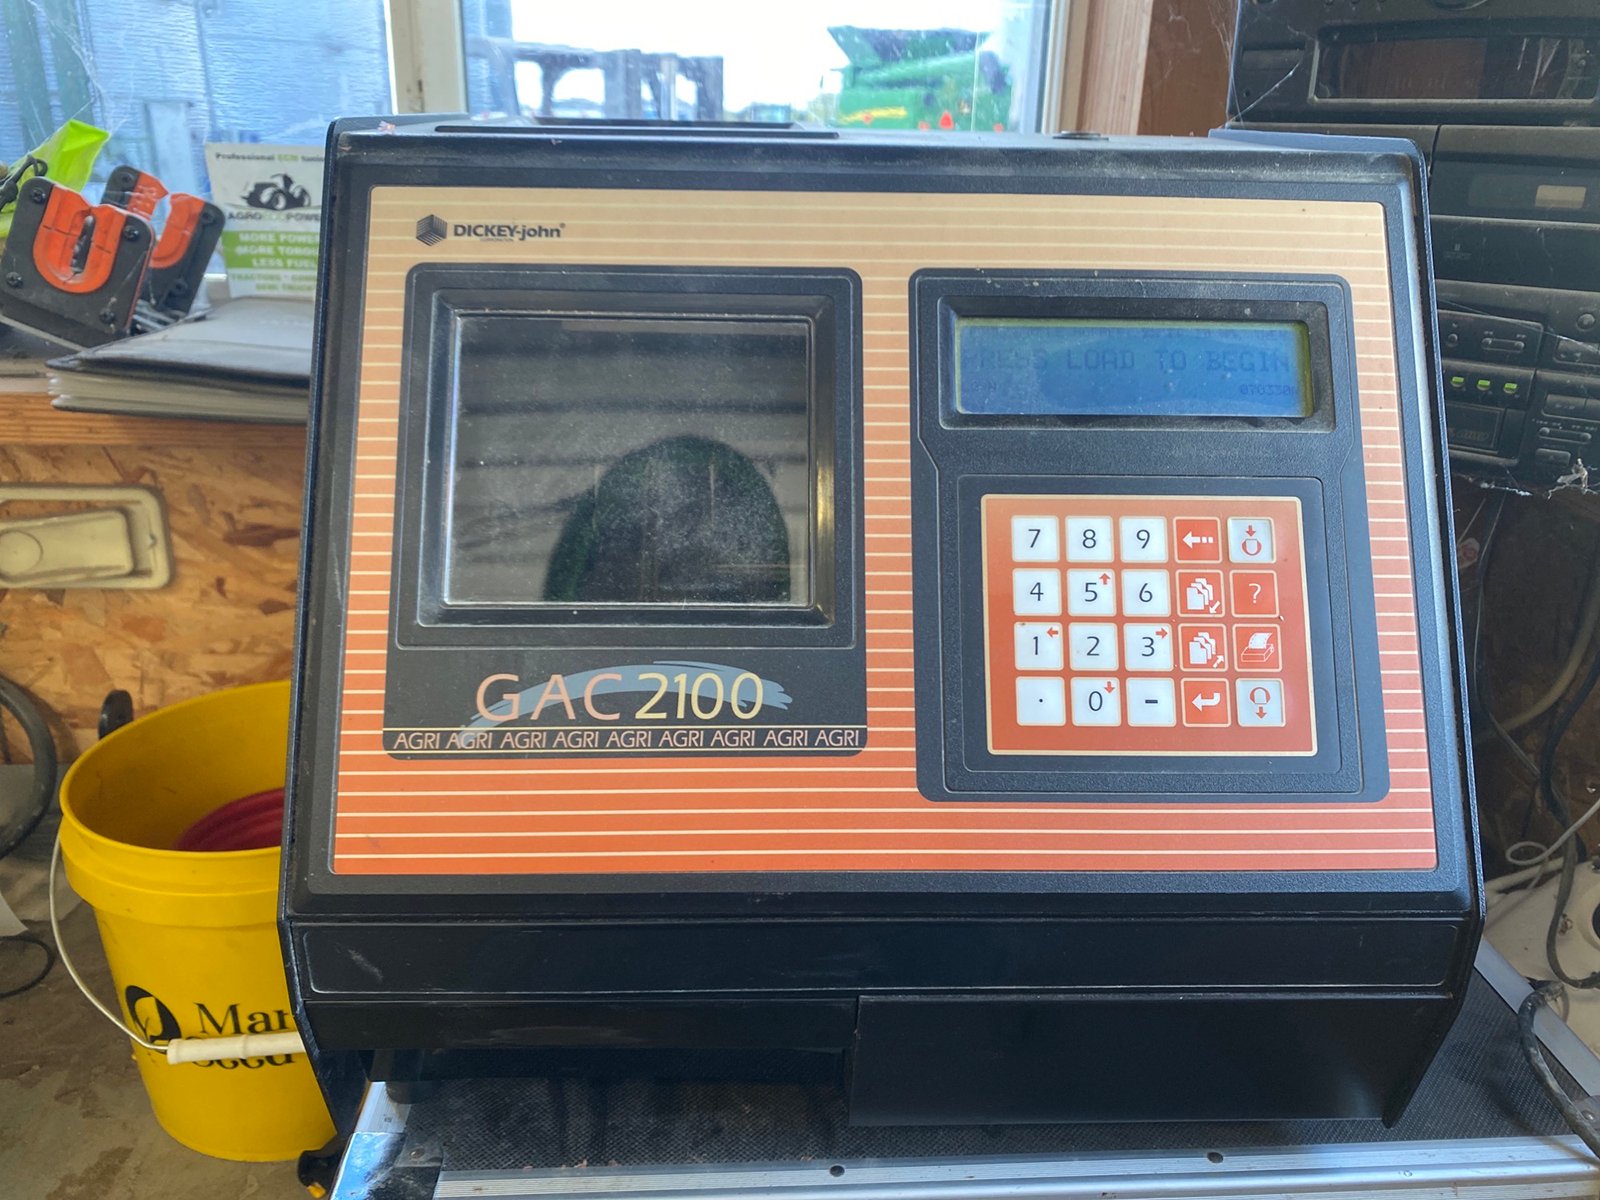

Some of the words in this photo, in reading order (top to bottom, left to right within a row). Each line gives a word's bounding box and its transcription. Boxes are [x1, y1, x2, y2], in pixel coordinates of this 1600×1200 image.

[239, 232, 276, 243] MORE
[1066, 349, 1136, 370] LOAD
[1154, 349, 1188, 371] TO
[1206, 350, 1291, 373] BEGIN
[1027, 529, 1041, 549] 7
[1082, 528, 1097, 549] 8
[1136, 529, 1151, 550] 9
[1029, 581, 1044, 602] 4
[1084, 582, 1098, 603] 5
[1138, 582, 1153, 603] 6
[1248, 582, 1262, 604] ?
[1031, 636, 1040, 656] 1
[1086, 635, 1100, 656] 2
[1141, 636, 1155, 657] 3
[475, 672, 623, 722] GAC
[634, 672, 765, 720] 2100
[1088, 690, 1103, 712] 0
[393, 732, 441, 750] AGRI
[445, 732, 494, 749] AGRI
[500, 731, 547, 749] AGRI
[552, 731, 600, 748] AGRI
[606, 731, 652, 748] AGRI
[658, 730, 705, 748] AGRI
[710, 730, 756, 747] AGRI
[763, 730, 809, 747] AGRI
[814, 729, 860, 747] AGRI
